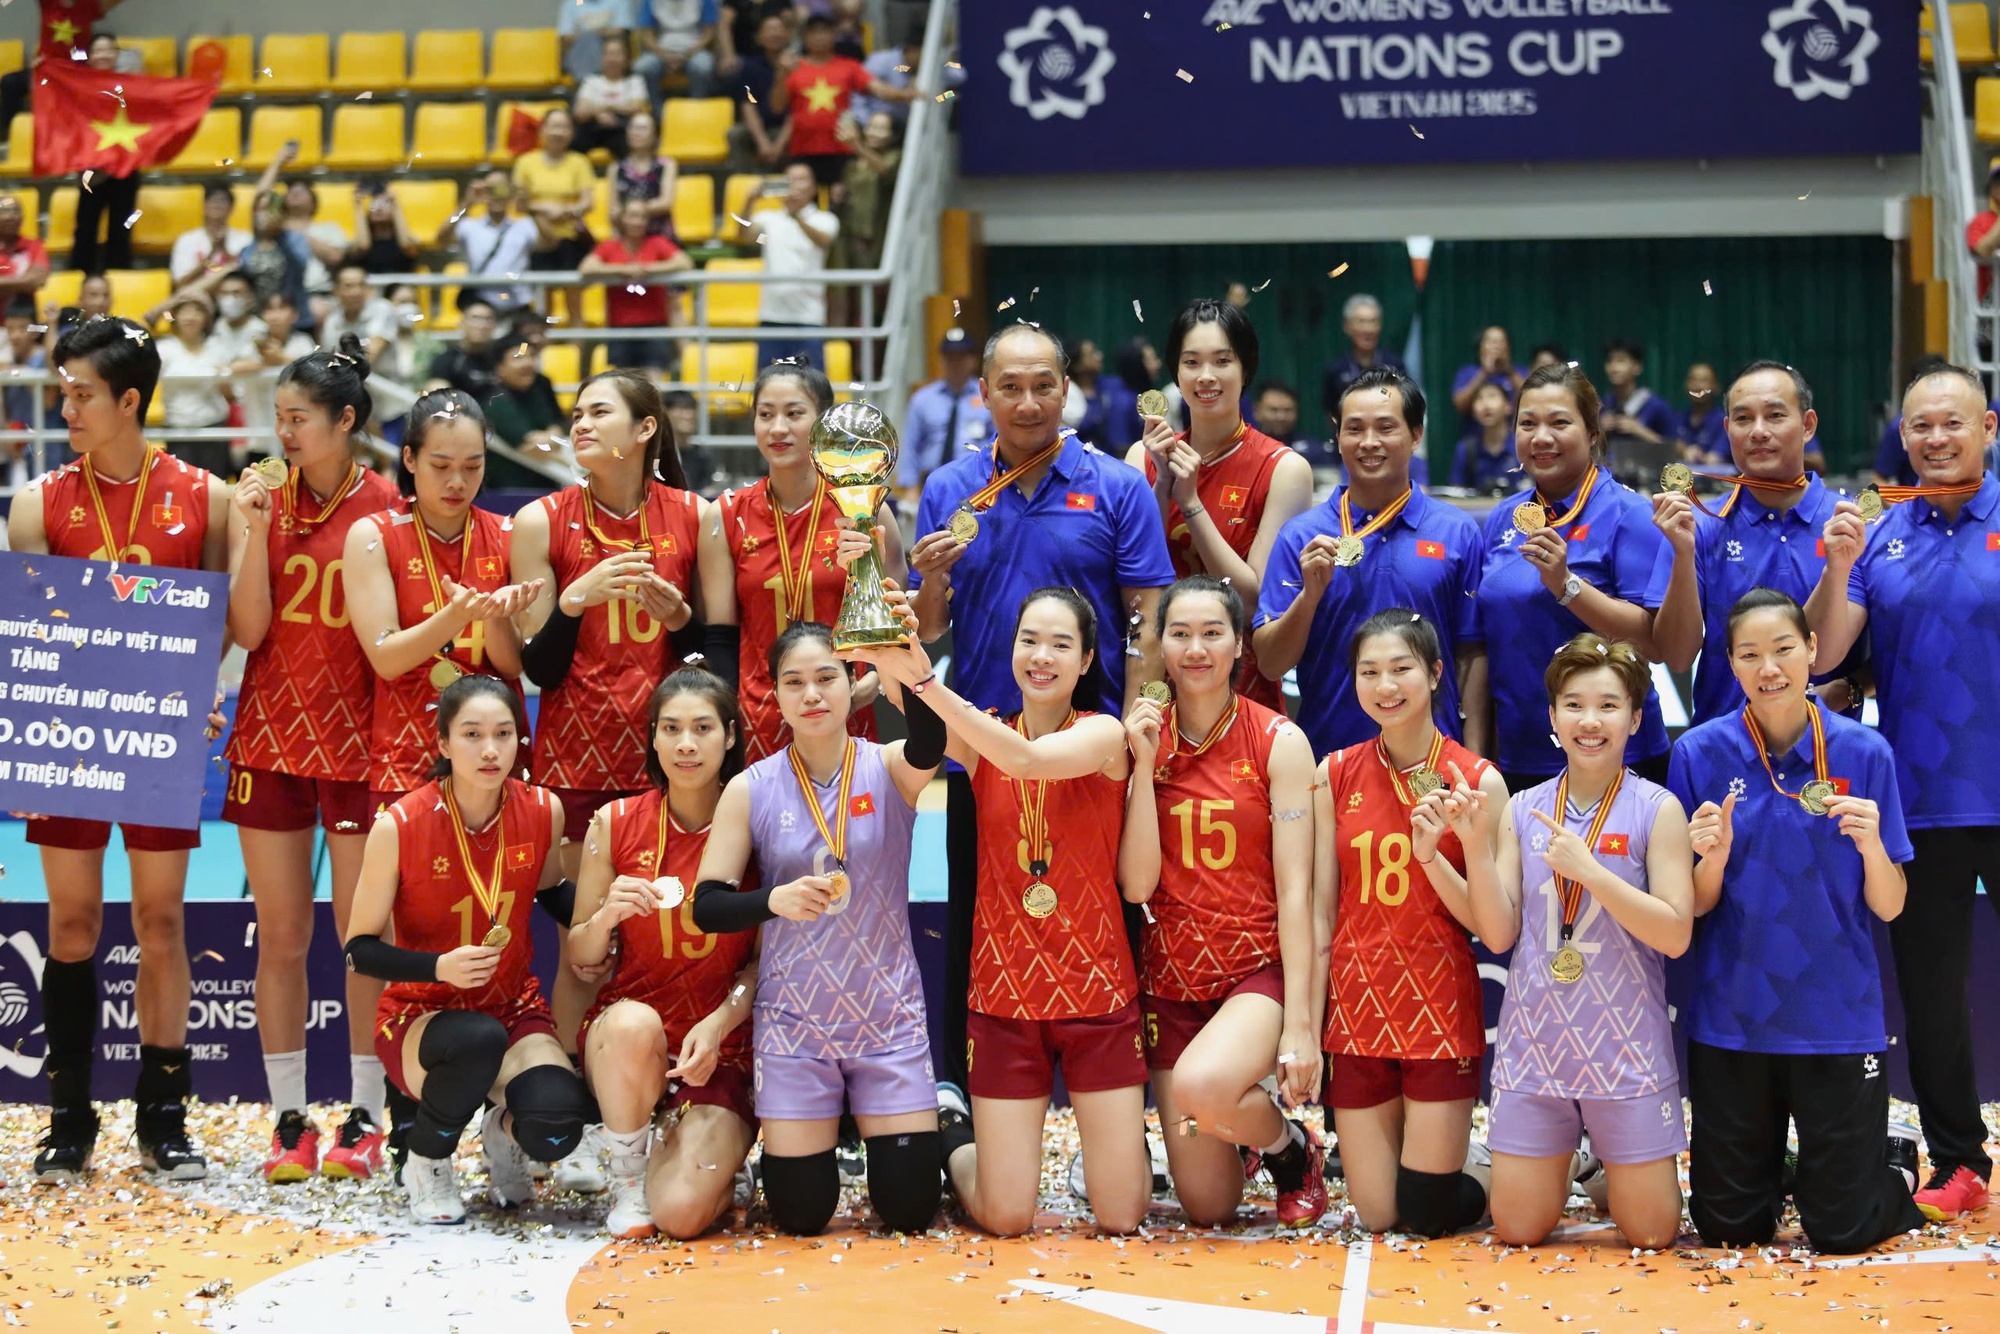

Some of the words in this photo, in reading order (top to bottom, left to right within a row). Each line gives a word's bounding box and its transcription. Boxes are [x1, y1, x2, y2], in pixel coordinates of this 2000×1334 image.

[1463, 0, 1672, 18] VOLLEYBALL
[1250, 31, 1492, 83] NATIONS
[1508, 29, 1624, 77] CUP
[281, 554, 351, 629] 20
[608, 584, 661, 644] 16
[52, 623, 89, 644] HÌNH
[91, 628, 123, 647] CÁP
[126, 631, 158, 652] VIỆT
[160, 636, 197, 654] NAM
[11, 646, 61, 672] TẶNG
[81, 689, 109, 709] NỮ
[110, 691, 156, 713] QUỐC
[159, 697, 188, 717] GIA
[103, 728, 177, 759] VNĐ
[16, 762, 69, 788] TRIỆU
[1170, 799, 1236, 871] 15
[1350, 830, 1411, 907] 18
[451, 891, 515, 948] 17
[1539, 875, 1603, 954] 12
[190, 980, 257, 994] VOLLEY
[102, 1000, 258, 1030] NONS
[305, 1000, 343, 1030] UP
[102, 1043, 142, 1061] VIET
